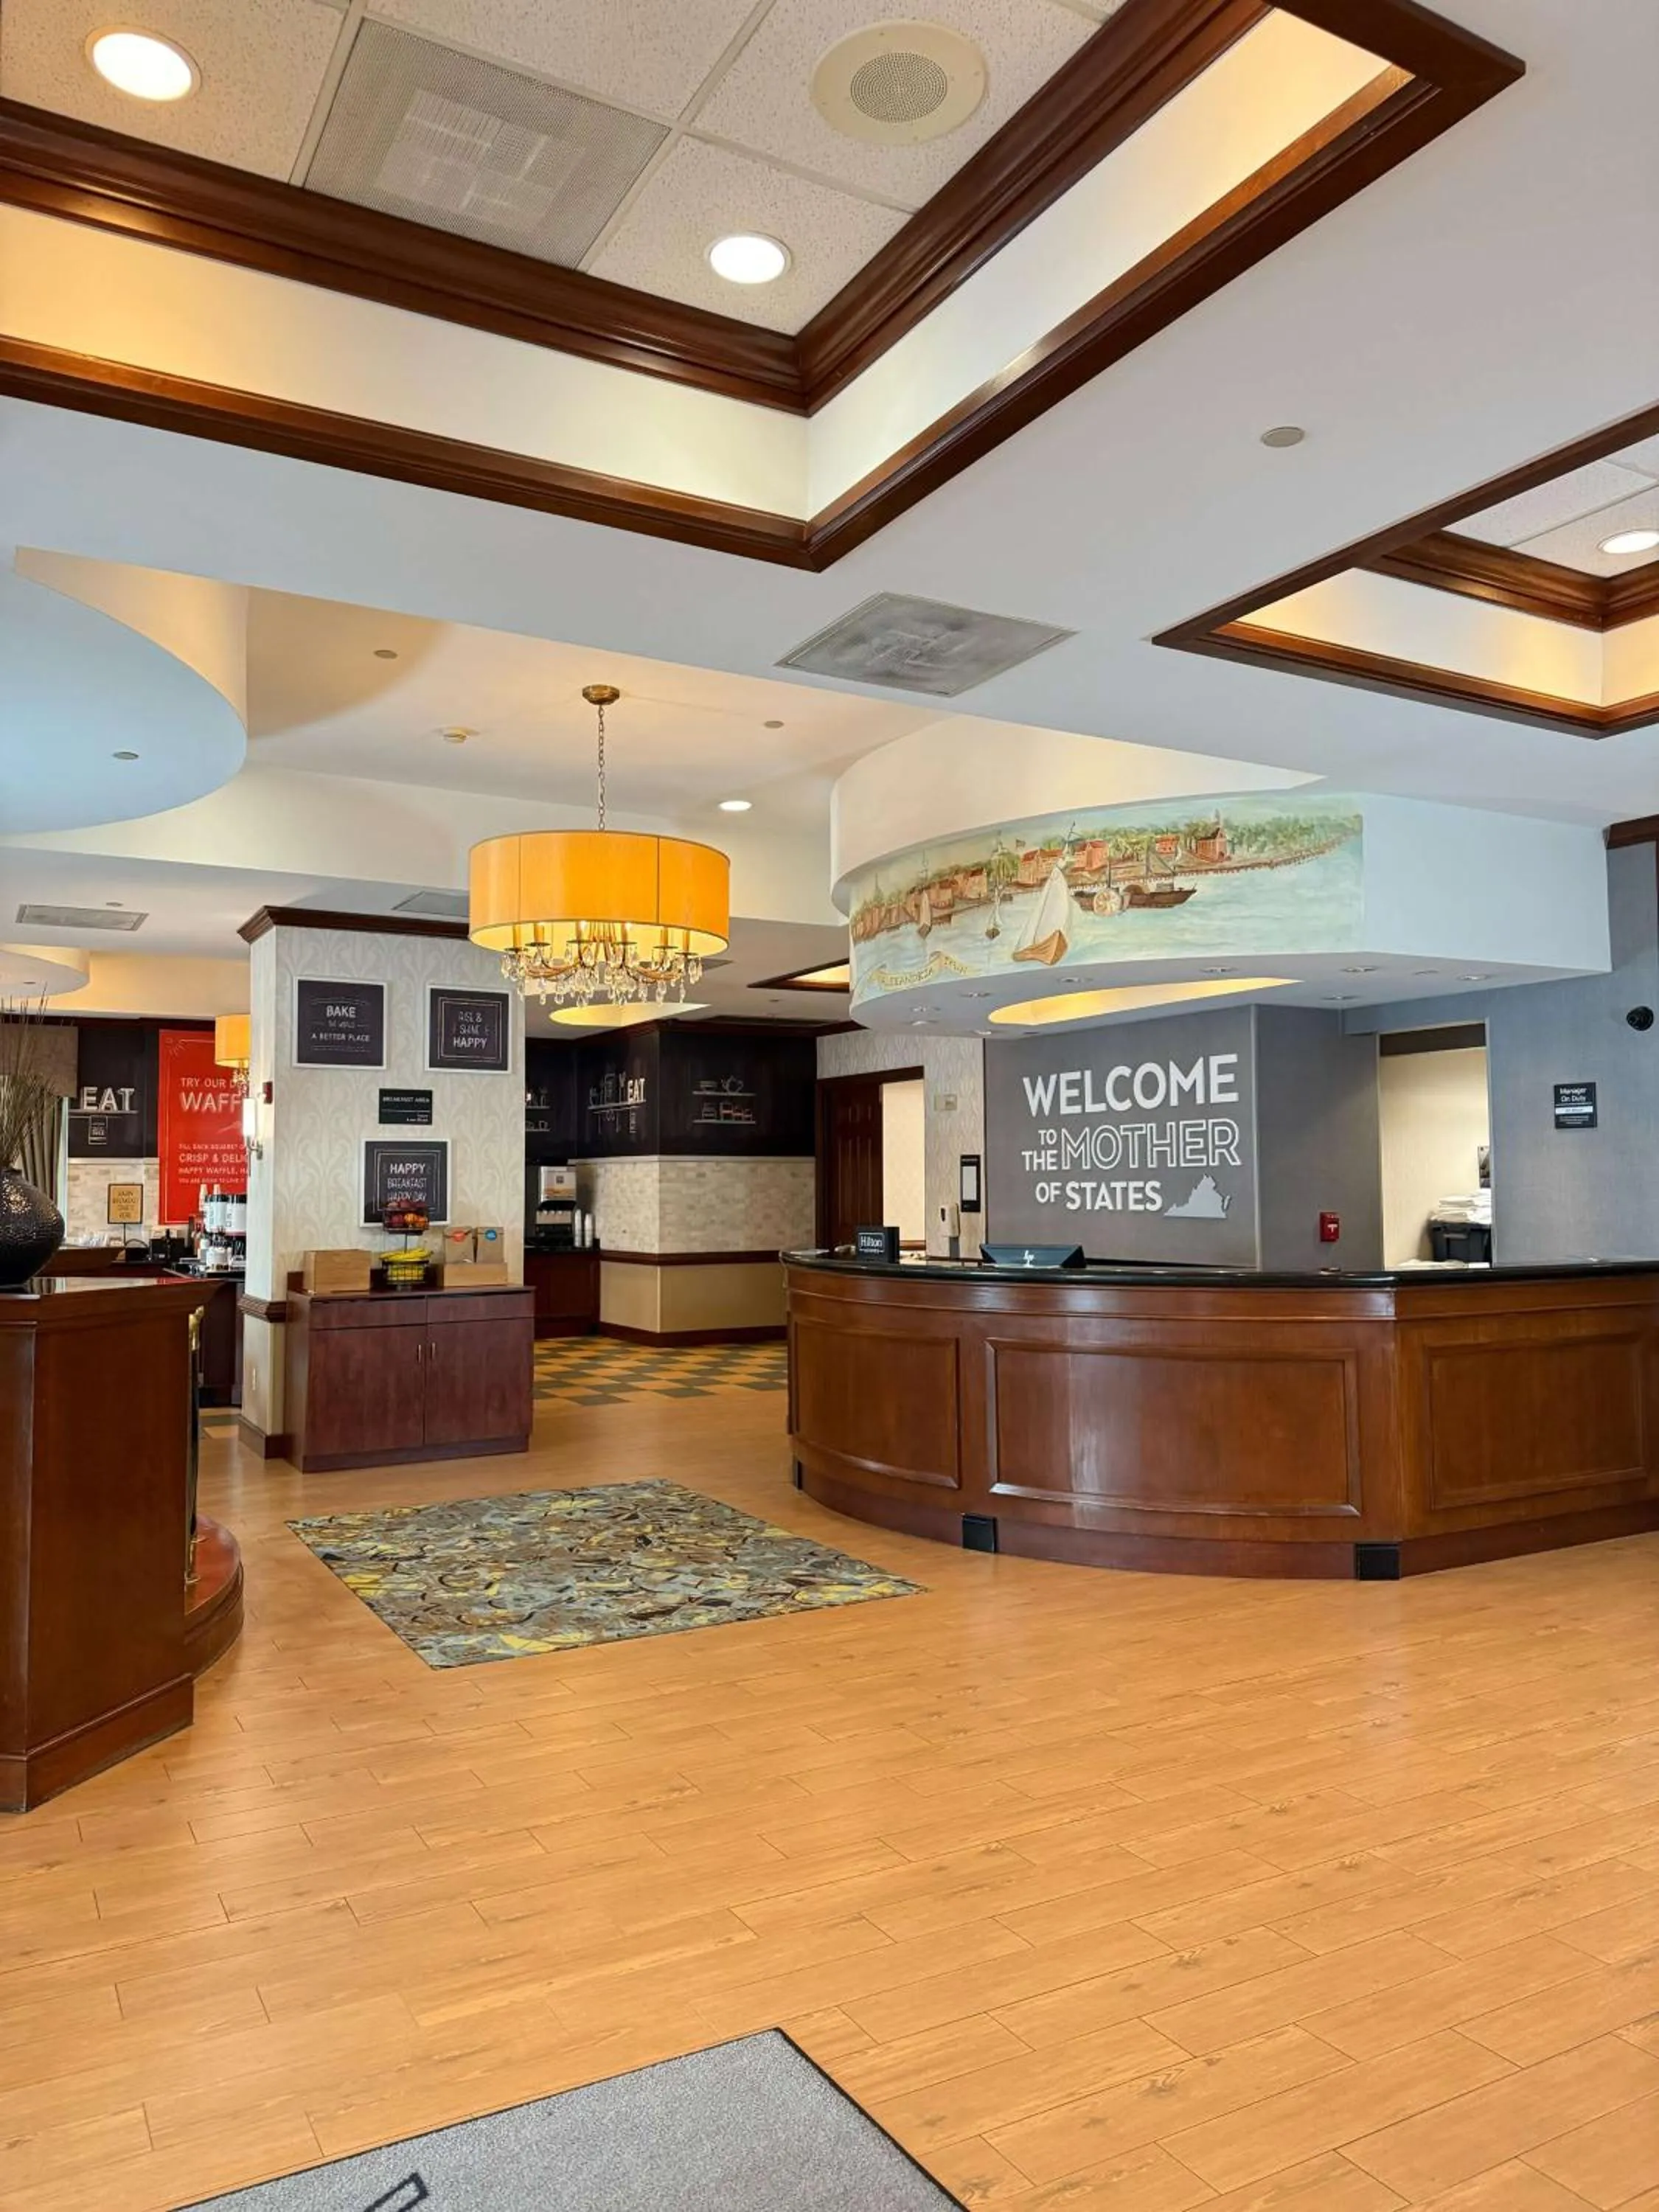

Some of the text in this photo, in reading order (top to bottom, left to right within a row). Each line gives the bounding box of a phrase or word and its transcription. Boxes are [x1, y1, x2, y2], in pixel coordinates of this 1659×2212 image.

[326, 1005, 357, 1018] BAKE
[453, 1037, 487, 1049] HAPPY
[181, 1077, 200, 1088] TRY
[204, 1078, 227, 1089] OUR
[1023, 1054, 1239, 1117] WELCOME
[627, 1078, 646, 1105] EAT
[81, 1086, 136, 1112] EAT
[179, 1091, 242, 1113] WAFF
[1038, 1129, 1057, 1145] TO
[1021, 1118, 1242, 1171] THE MOTHER
[178, 1152, 209, 1163] CRISP
[389, 1163, 426, 1175] HAPPY
[386, 1177, 427, 1189] BREAKFAST
[1035, 1180, 1164, 1211] OF STATES
[860, 1236, 883, 1247] Hilton
